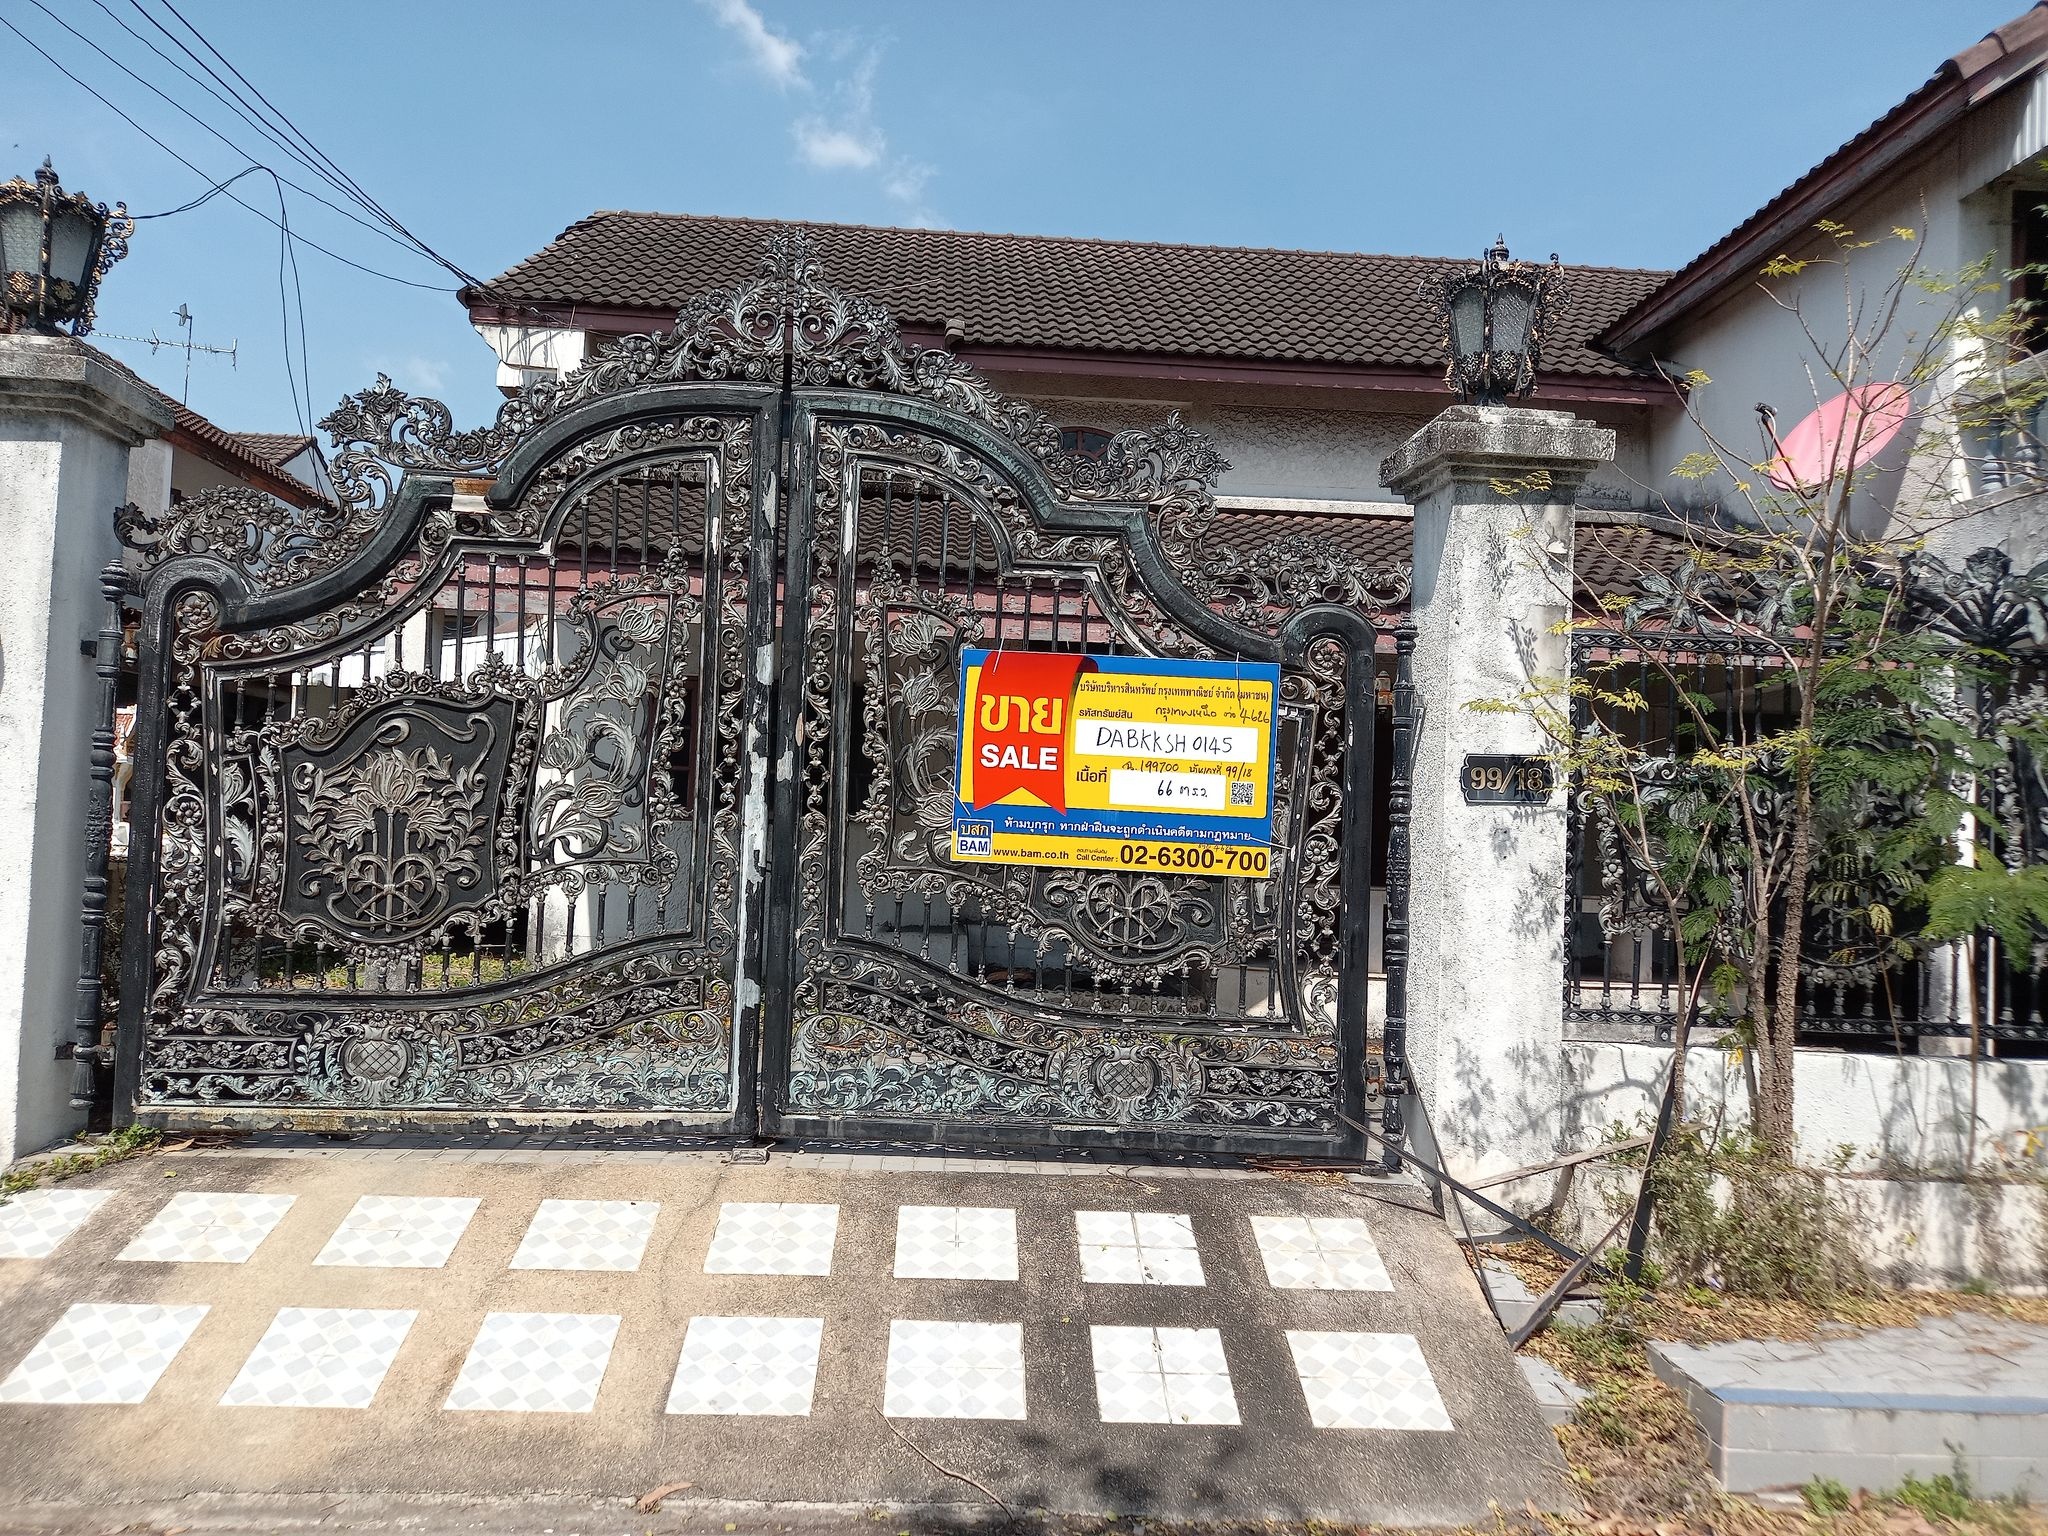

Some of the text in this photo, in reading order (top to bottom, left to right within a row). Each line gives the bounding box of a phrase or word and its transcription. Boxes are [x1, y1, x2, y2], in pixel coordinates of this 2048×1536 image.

[1216, 687, 1235, 699] จำกัด
[1237, 691, 1269, 703] (มหาชน)
[981, 694, 1062, 735] ขาย
[1079, 708, 1133, 719] รหัสทรัพย์สิน
[1240, 707, 1270, 724] 4626
[1096, 726, 1233, 755] DABKKSH 0145
[980, 743, 1059, 770] SALE
[1076, 765, 1108, 783] เนื้อที่
[1140, 760, 1180, 774] 199700
[1225, 762, 1253, 781] 99/18
[1157, 779, 1173, 797] 66
[1471, 765, 1543, 795] 99/18
[960, 823, 989, 837] บสก
[1004, 816, 1055, 833] ห้ามบุกรุก
[959, 839, 989, 853] BAM
[993, 848, 1069, 860] www.bam.co.th
[1120, 845, 1267, 872] 02-6300-700
